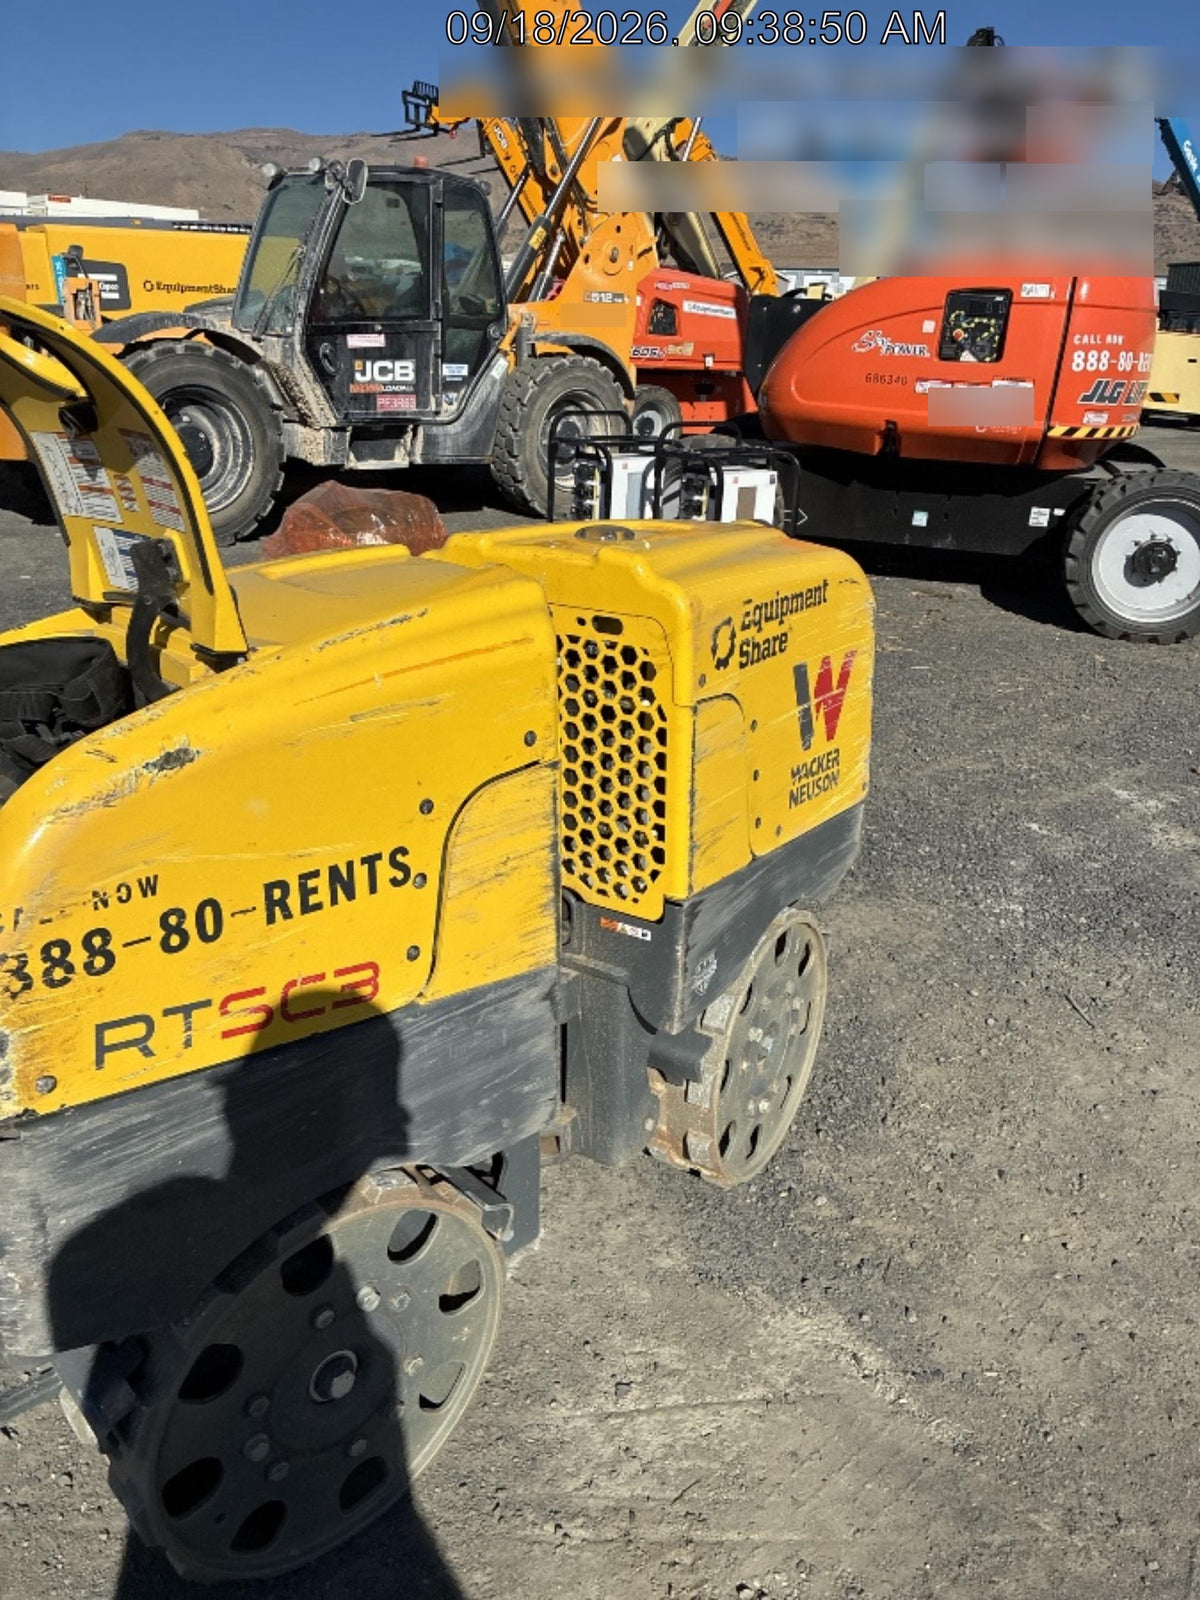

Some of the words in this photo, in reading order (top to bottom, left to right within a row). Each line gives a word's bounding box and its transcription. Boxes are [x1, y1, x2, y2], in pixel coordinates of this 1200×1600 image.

[155, 281, 238, 295] EquipmentShar
[1073, 334, 1102, 345] CALL
[355, 360, 416, 382] JCB
[1077, 378, 1128, 406] JLG
[740, 578, 830, 633] Equipment
[739, 630, 789, 669] Share
[791, 748, 840, 785] WACKER
[788, 770, 840, 810] NEUSON
[90, 873, 160, 912] NOW
[94, 960, 381, 1071] RTSC3
